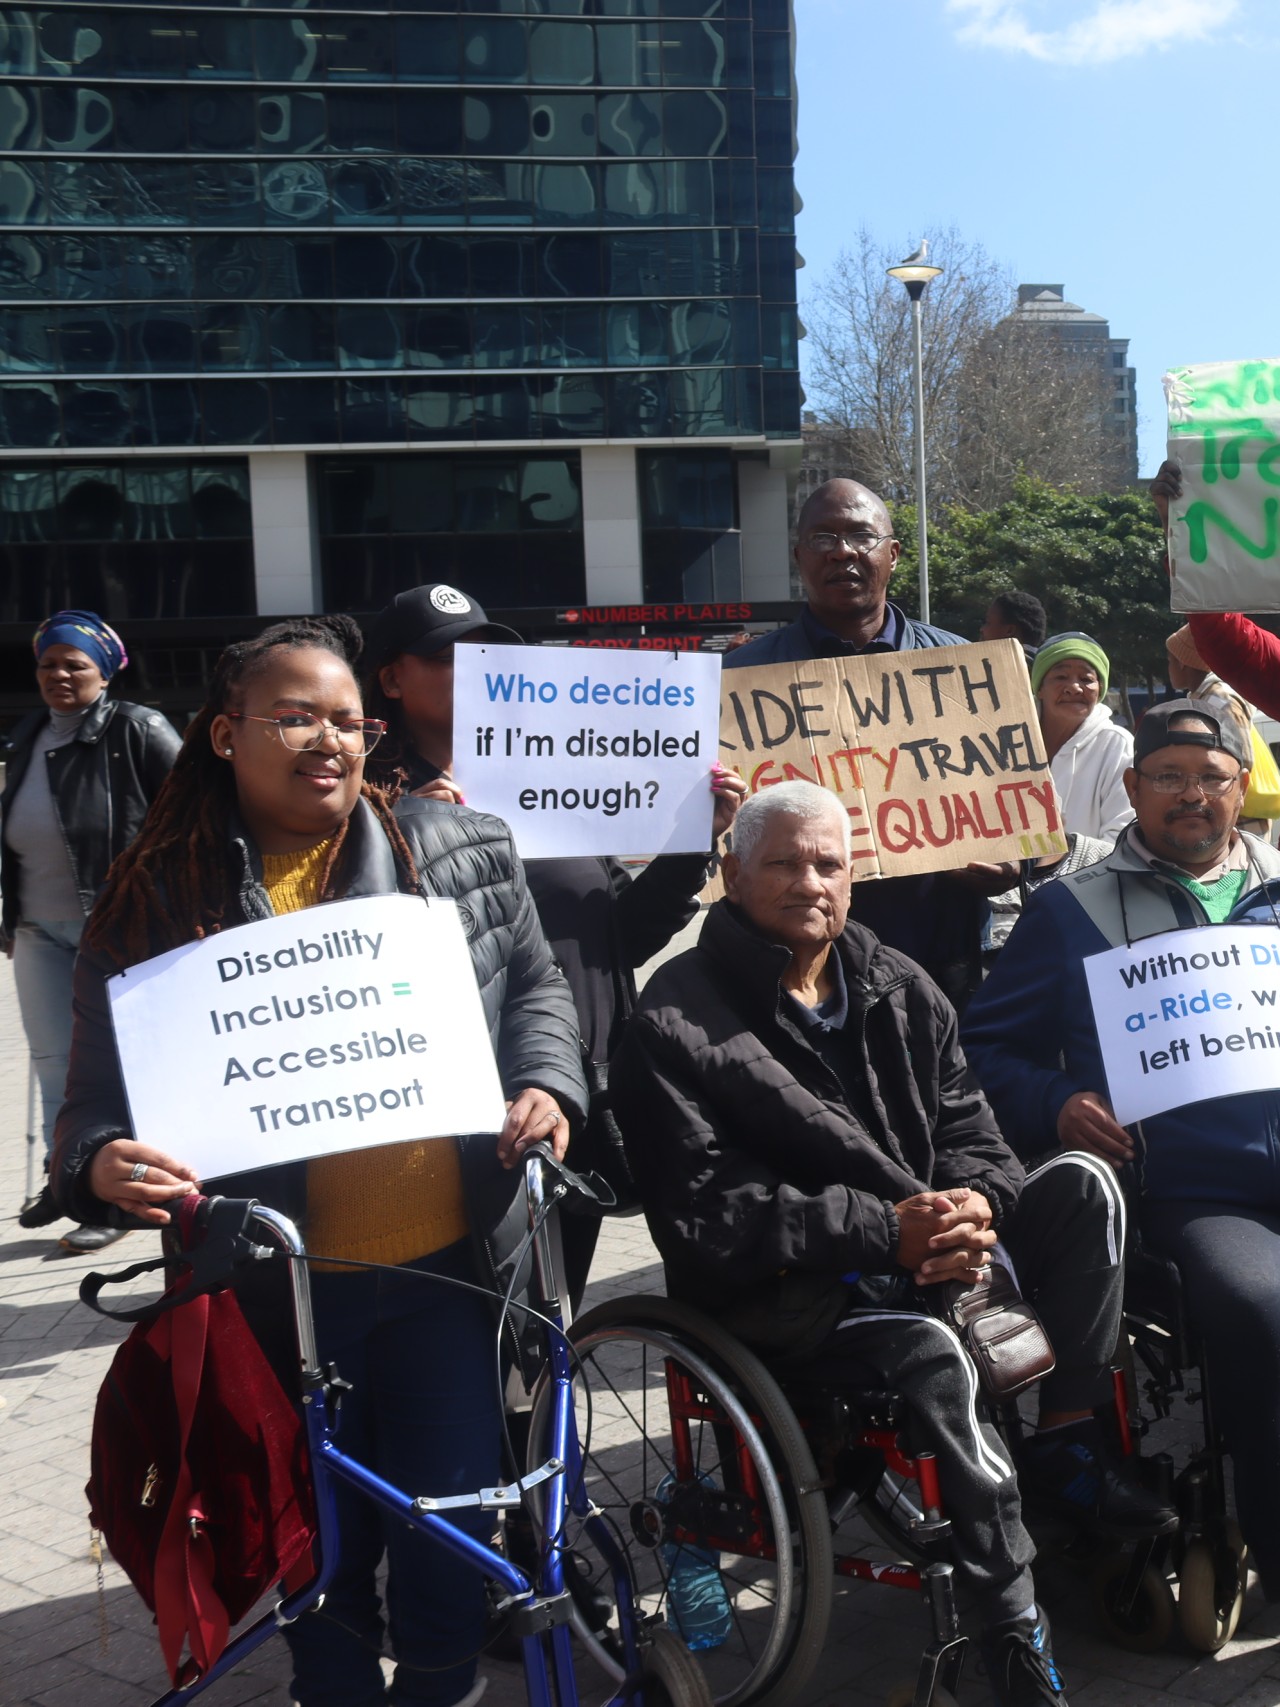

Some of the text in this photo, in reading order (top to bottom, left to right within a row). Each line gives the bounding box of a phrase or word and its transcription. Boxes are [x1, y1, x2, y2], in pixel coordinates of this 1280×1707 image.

[581, 606, 667, 624] NUMBER
[674, 604, 752, 620] PLATES
[484, 673, 695, 707] Who decides
[843, 658, 1001, 728] WITH
[476, 726, 700, 757] if I'm disabled
[899, 722, 1050, 782] TRAVEL
[518, 780, 660, 816] enough?
[1073, 869, 1108, 884] BL
[217, 929, 383, 983] Disability
[1119, 944, 1242, 990] Without
[210, 982, 412, 1035] Inclusion =
[1124, 988, 1243, 1033] a-Ride,
[223, 1027, 428, 1087] Accessible
[1140, 1038, 1191, 1075] left
[250, 1078, 425, 1134] Transport
